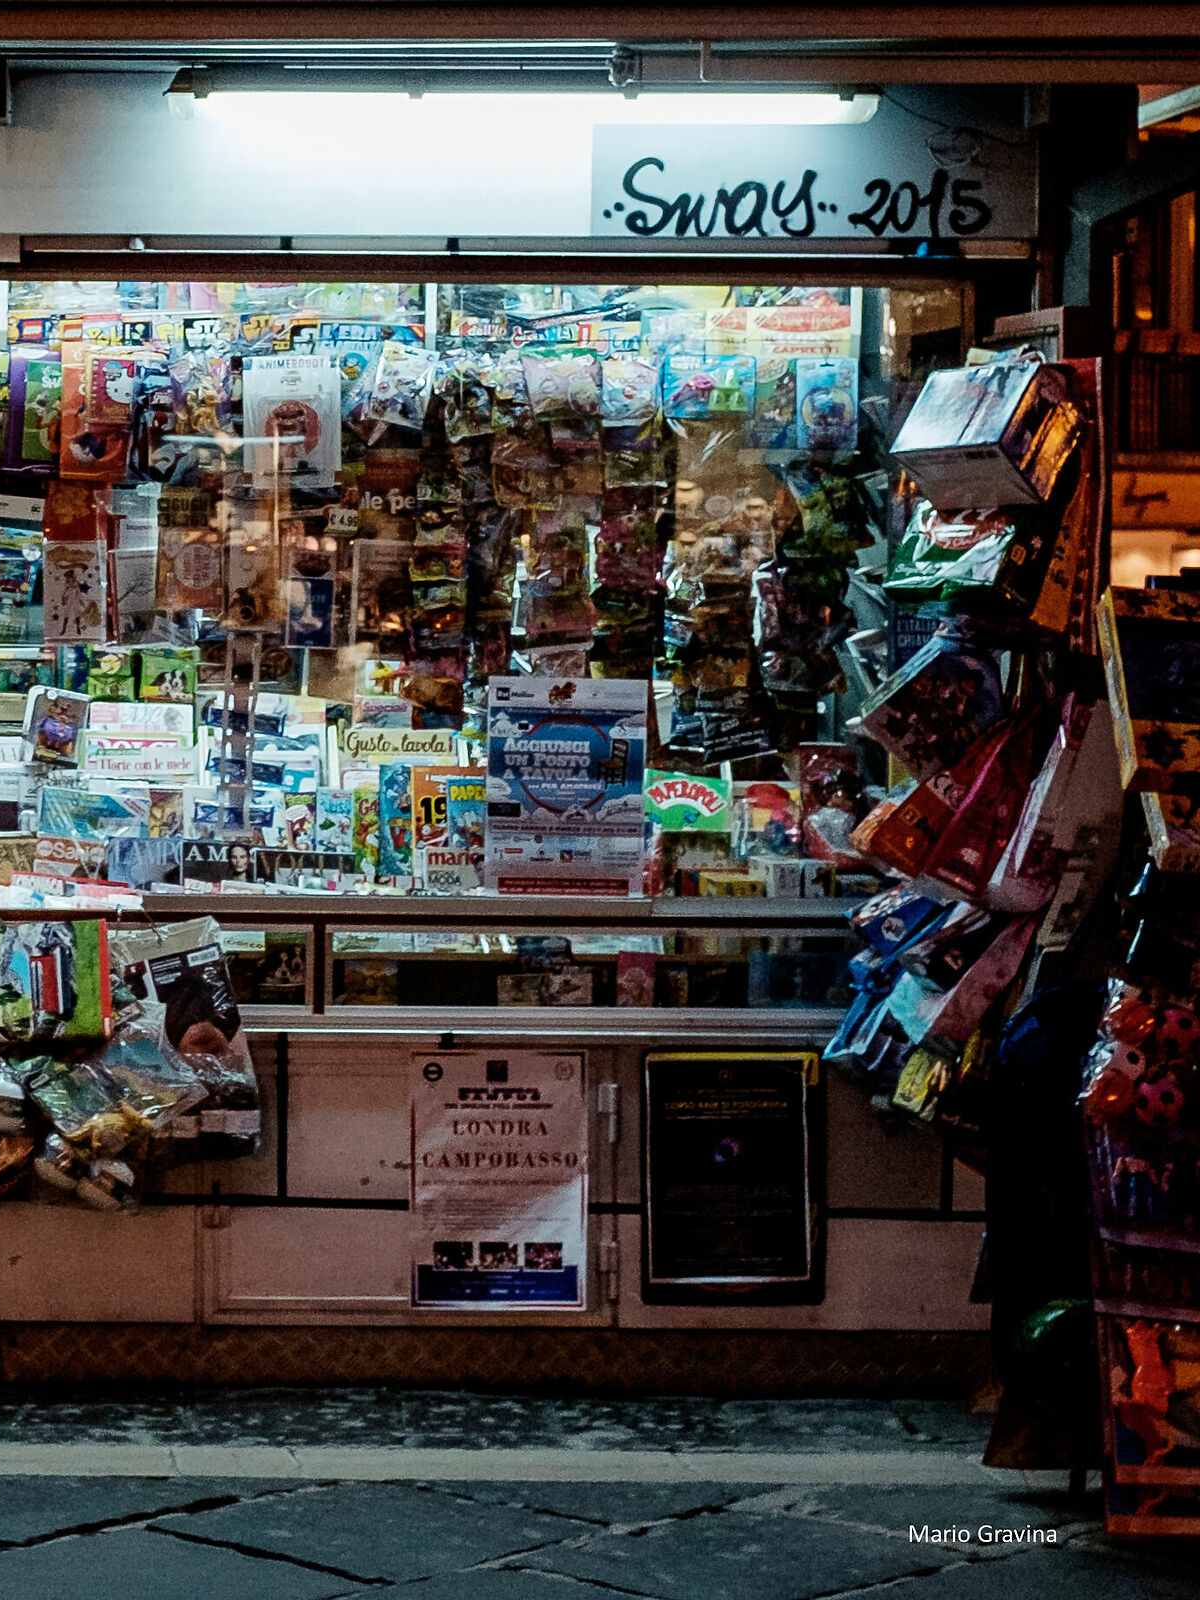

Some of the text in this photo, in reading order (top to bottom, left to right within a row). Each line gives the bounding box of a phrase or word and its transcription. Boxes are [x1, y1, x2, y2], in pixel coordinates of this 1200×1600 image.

[848, 169, 992, 237] 2015
[347, 732, 390, 757] Gusto
[504, 753, 591, 767] UN POSTO
[520, 767, 590, 781] TAVOLA
[452, 1120, 548, 1136] LONDRA
[422, 1152, 579, 1168] CAMPOBASSO
